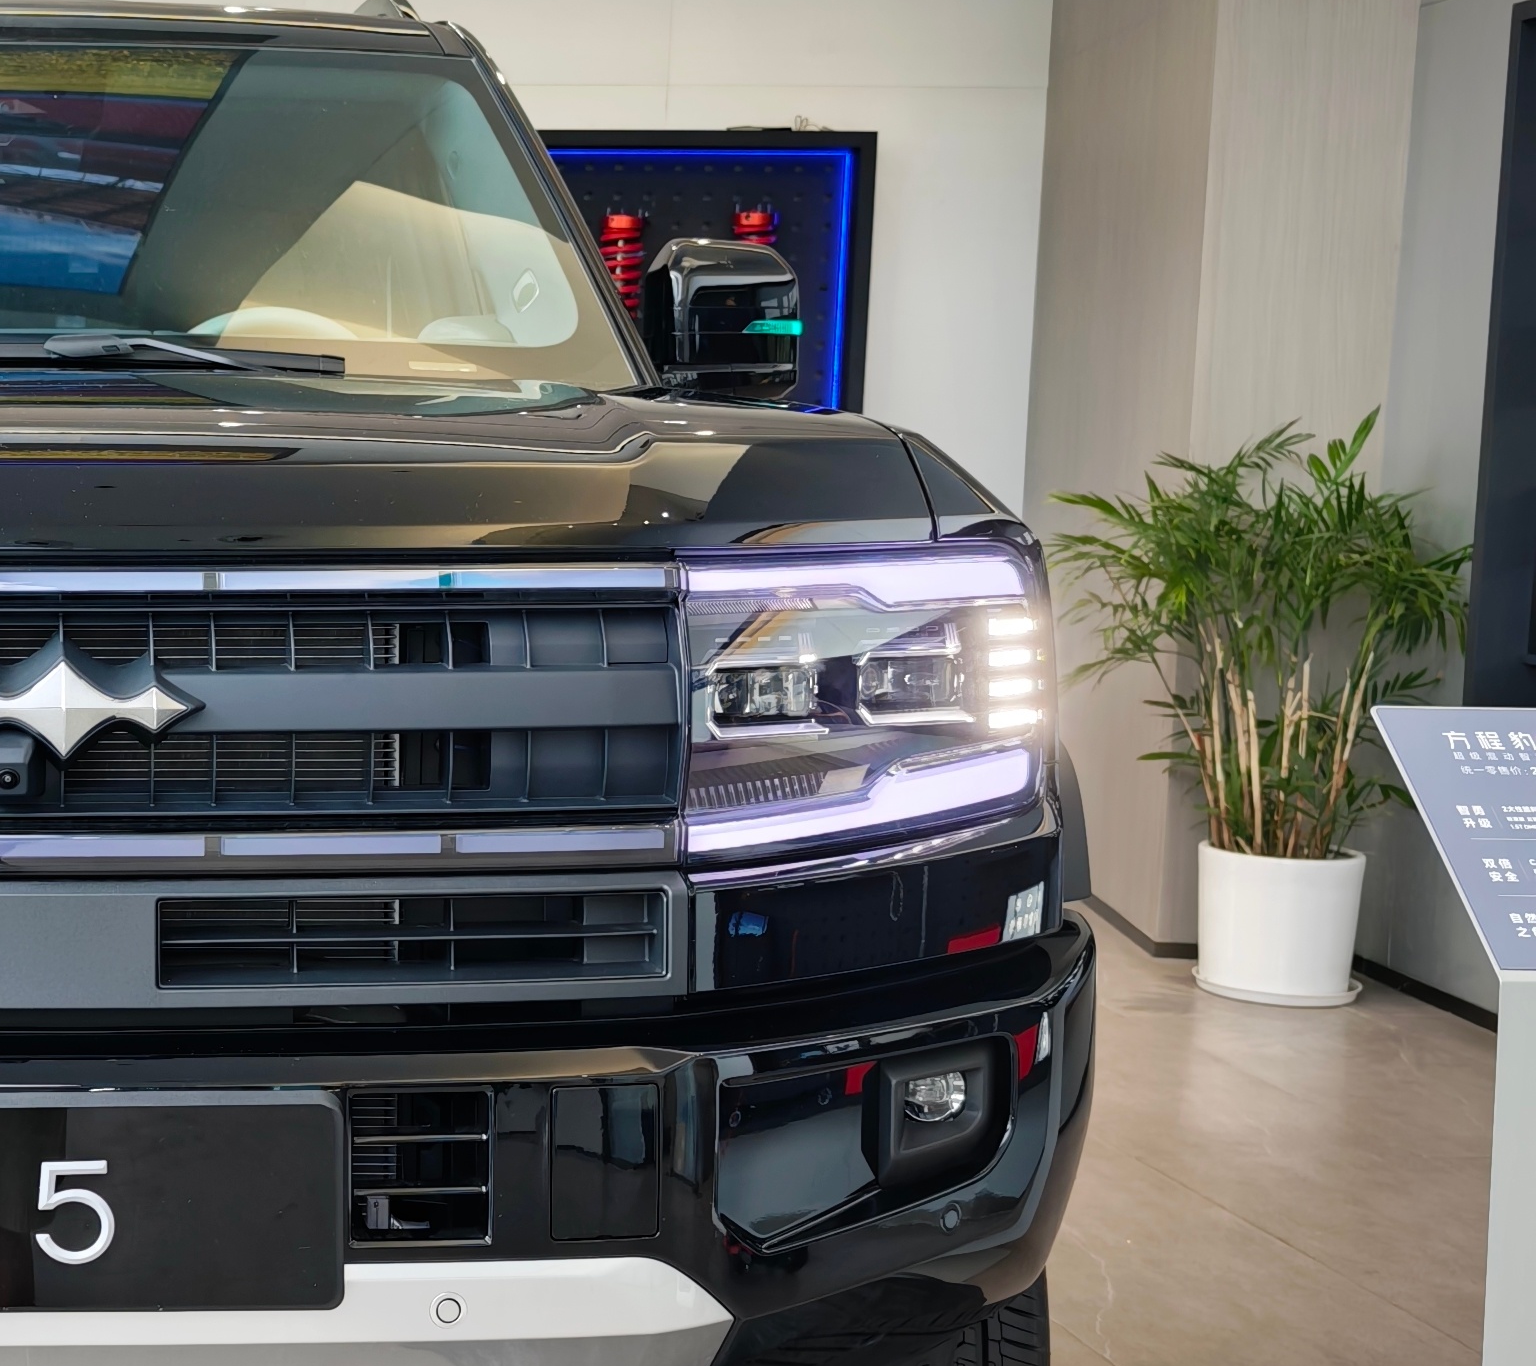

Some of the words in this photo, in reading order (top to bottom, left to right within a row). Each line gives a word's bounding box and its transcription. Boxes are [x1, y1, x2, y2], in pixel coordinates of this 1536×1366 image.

[1441, 731, 1536, 750] 方程豹
[1453, 752, 1536, 761] 超级混动智
[1482, 858, 1513, 869] 双倍
[1488, 871, 1520, 882] 安全
[34, 1159, 116, 1266] 5
